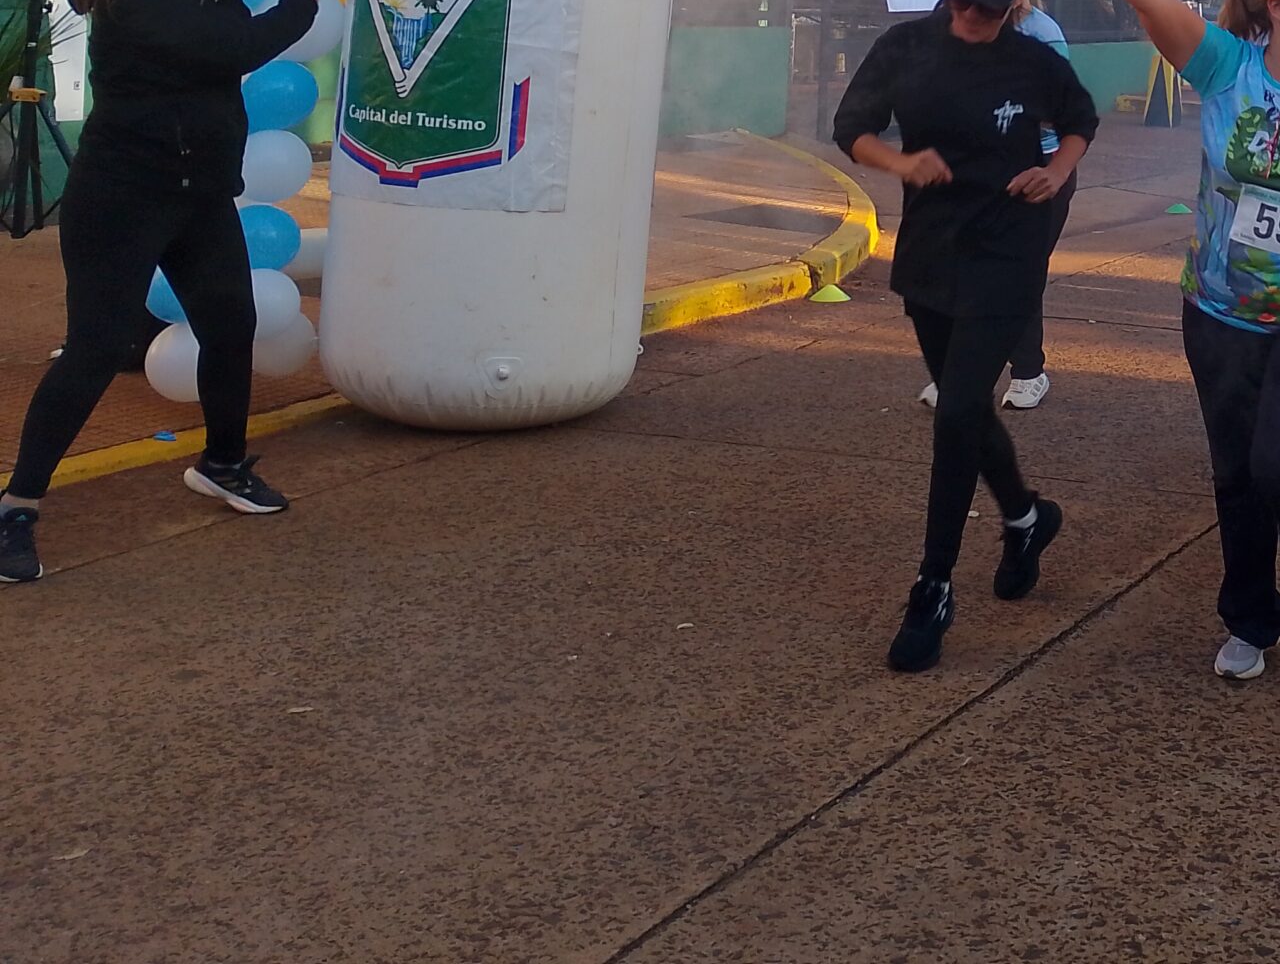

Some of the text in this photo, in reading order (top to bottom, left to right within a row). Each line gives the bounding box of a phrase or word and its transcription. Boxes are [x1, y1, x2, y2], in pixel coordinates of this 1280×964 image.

[348, 103, 487, 132] Capital del Turismo
